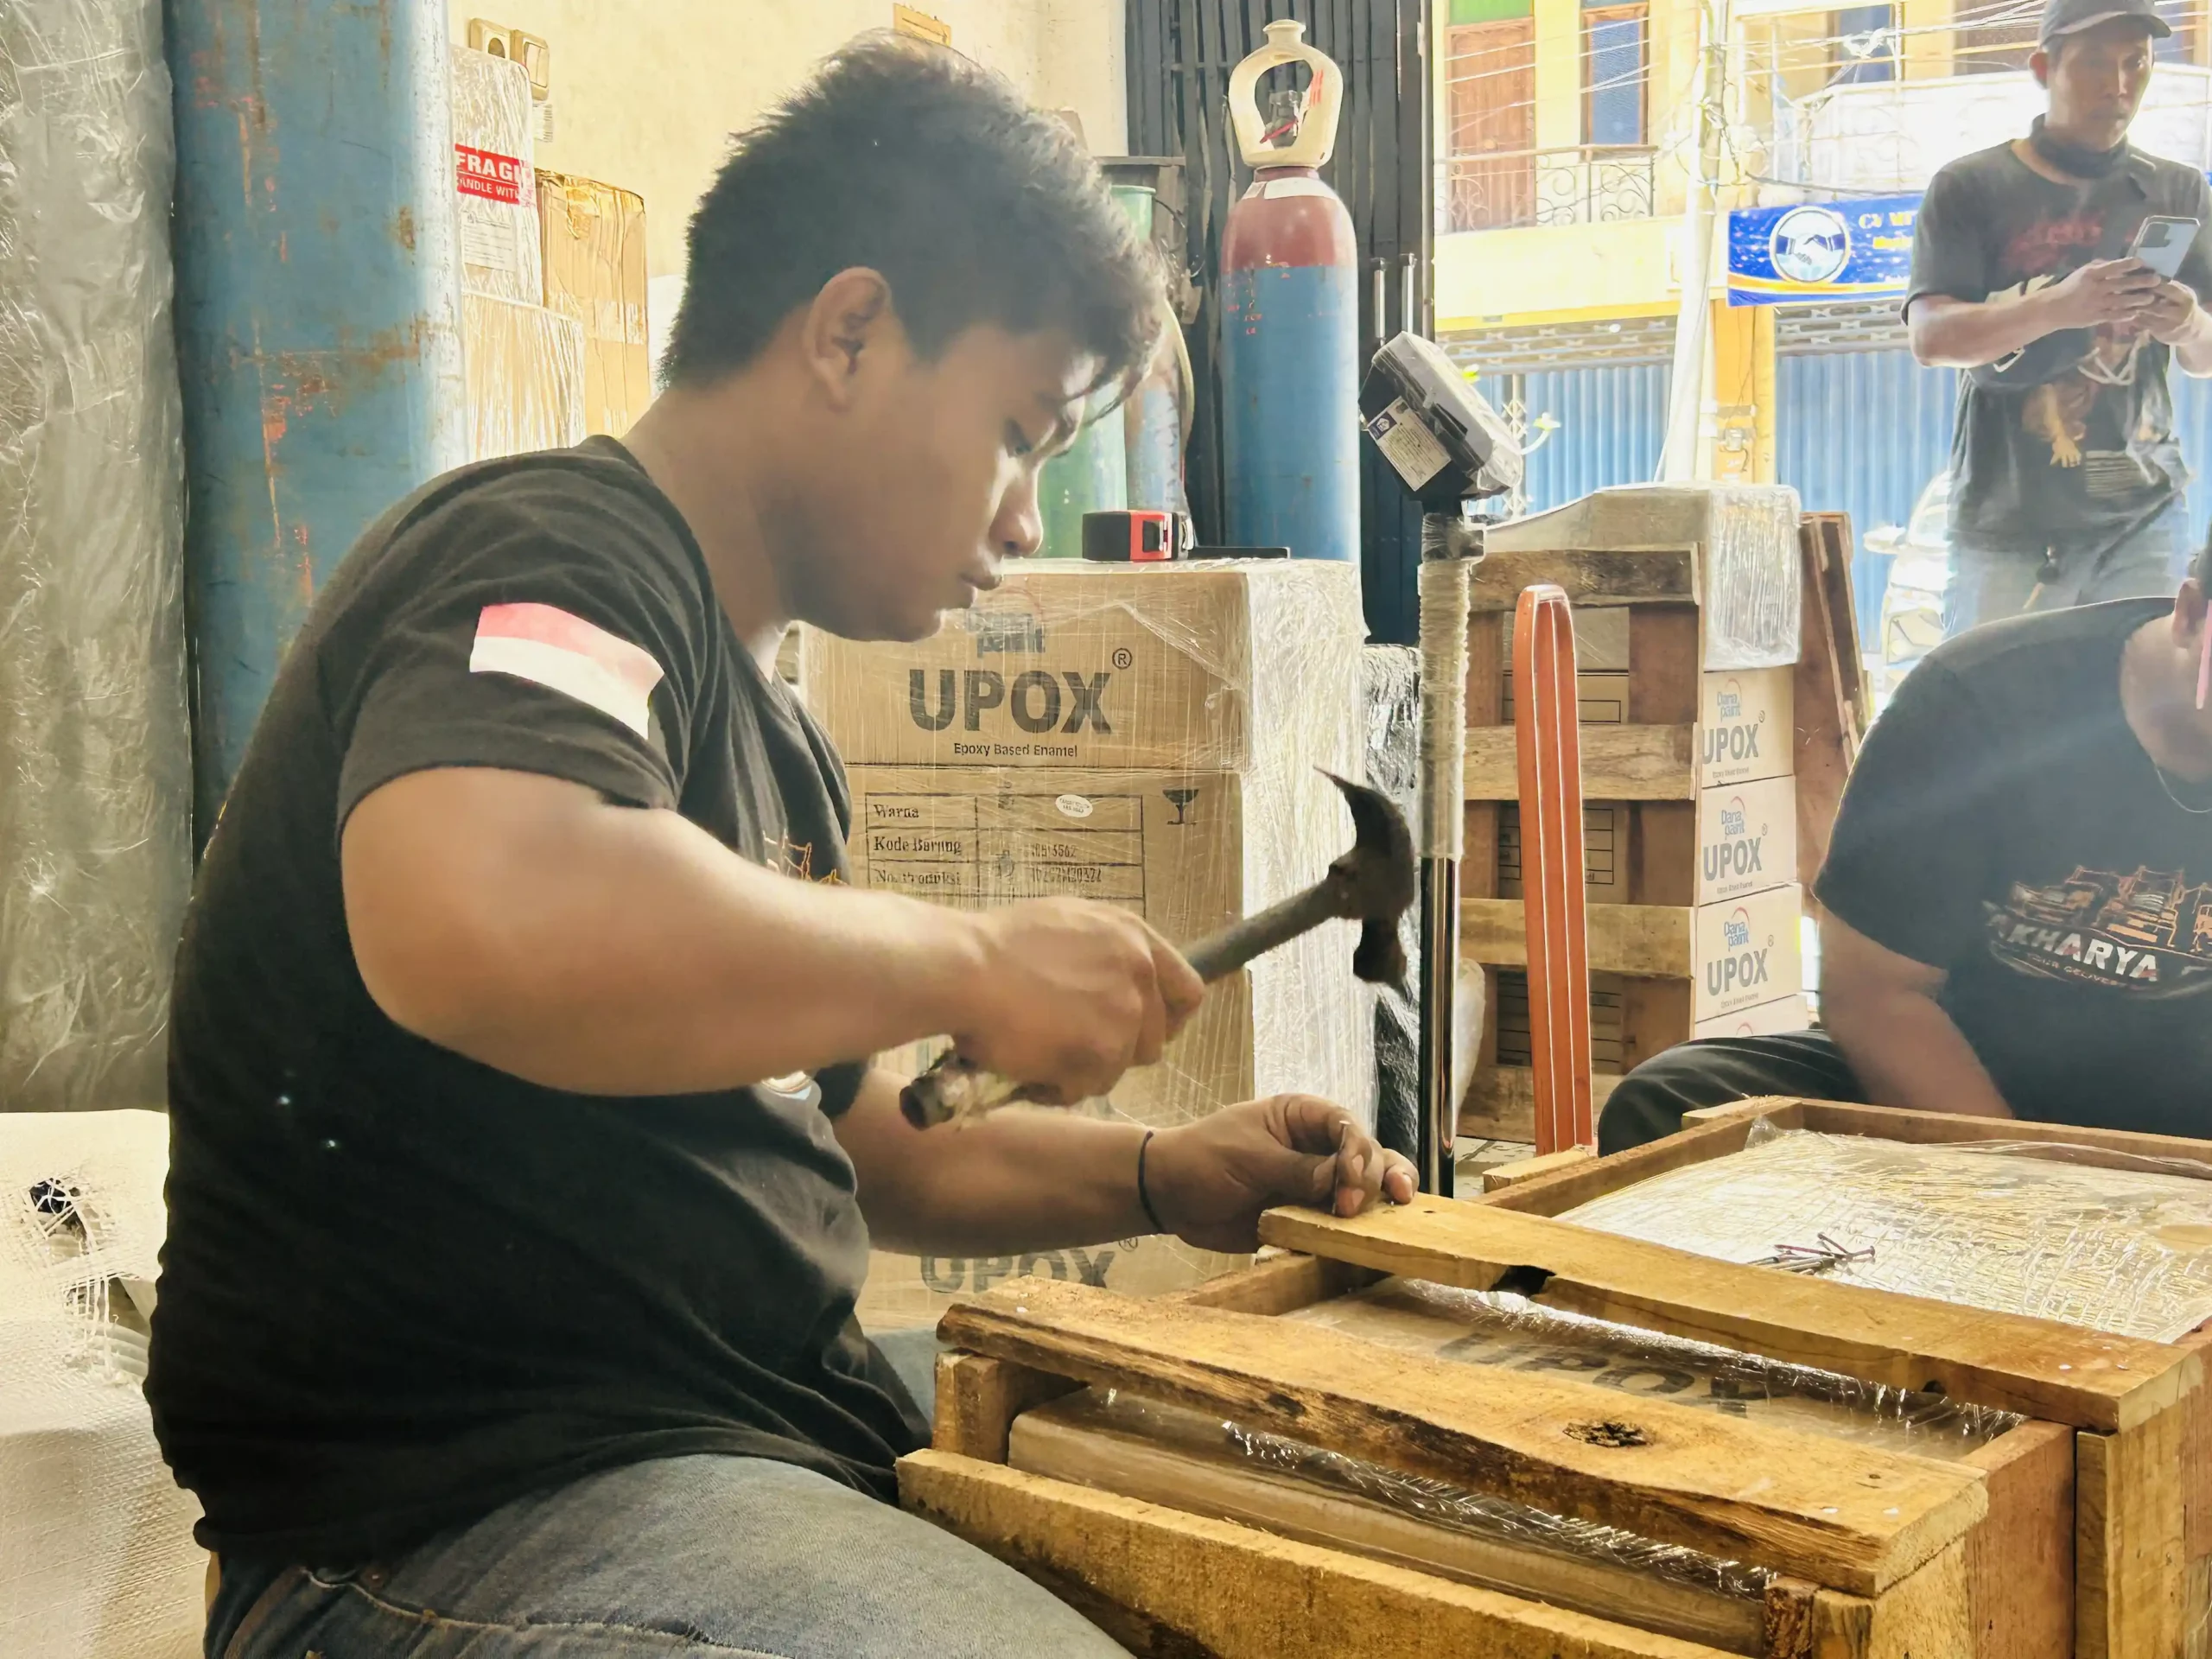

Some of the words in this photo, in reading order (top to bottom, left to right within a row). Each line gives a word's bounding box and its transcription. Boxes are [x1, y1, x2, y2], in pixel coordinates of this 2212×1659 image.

[909, 669, 1112, 734] UPOX
[954, 742, 990, 757] Epoxy
[994, 743, 1030, 756] Based
[1033, 745, 1077, 757] Enamel
[1702, 723, 1759, 765] UPOX
[1720, 809, 1742, 825] Dana
[874, 836, 910, 851] Kode
[1703, 836, 1763, 881] UPOX
[1724, 921, 1745, 937] Dana
[1707, 948, 1768, 996] UPOX
